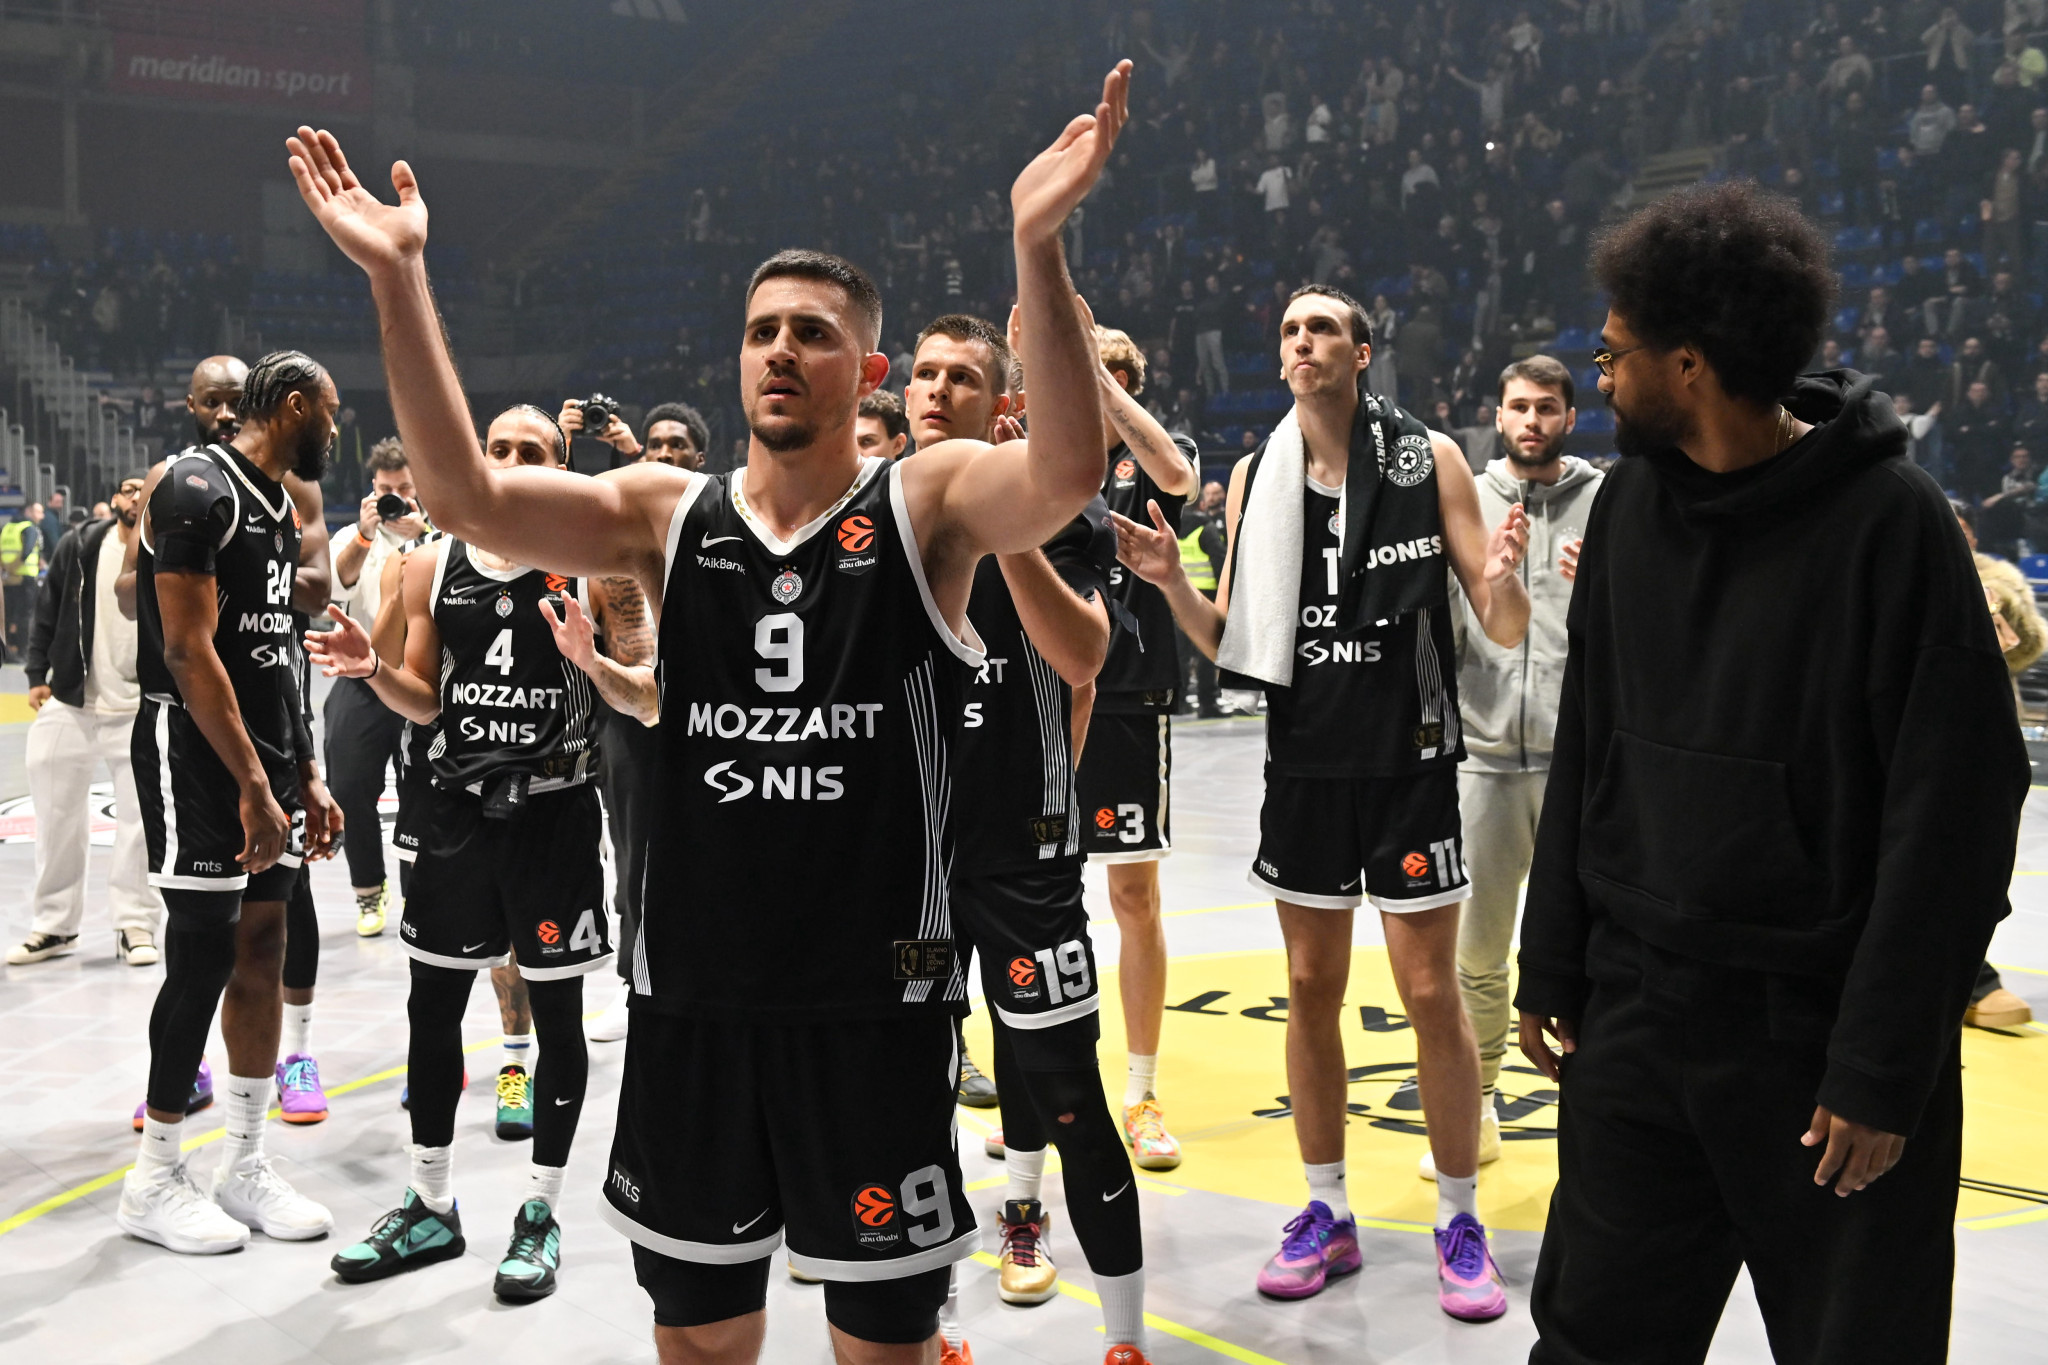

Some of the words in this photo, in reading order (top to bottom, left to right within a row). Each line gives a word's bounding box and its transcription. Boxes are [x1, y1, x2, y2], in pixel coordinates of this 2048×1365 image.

[128, 54, 350, 96] meridian:sport
[702, 557, 746, 576] AikBank
[838, 561, 854, 569] abu
[854, 556, 876, 567] dhabi
[1366, 535, 1442, 569] JONES
[267, 559, 292, 606] 24
[1322, 547, 1342, 595] 1
[238, 612, 293, 634] MOZZAR
[484, 628, 514, 676] 4
[754, 612, 804, 693] 9
[1332, 640, 1382, 663] NIS
[488, 720, 536, 744] NIS
[687, 702, 884, 742] MOZZART
[762, 766, 844, 801] NIS
[291, 809, 307, 853] 2
[399, 833, 419, 847] mts
[1117, 803, 1145, 844] 3
[193, 860, 223, 873] mts
[1259, 859, 1279, 878] mts
[1429, 837, 1461, 888] 11
[401, 920, 417, 939] mts
[568, 908, 603, 956] 4
[1034, 939, 1091, 1005] 19
[612, 1169, 641, 1203] mts
[899, 1164, 956, 1248] 9
[860, 1235, 875, 1243] abu
[875, 1232, 899, 1242] dhabi
